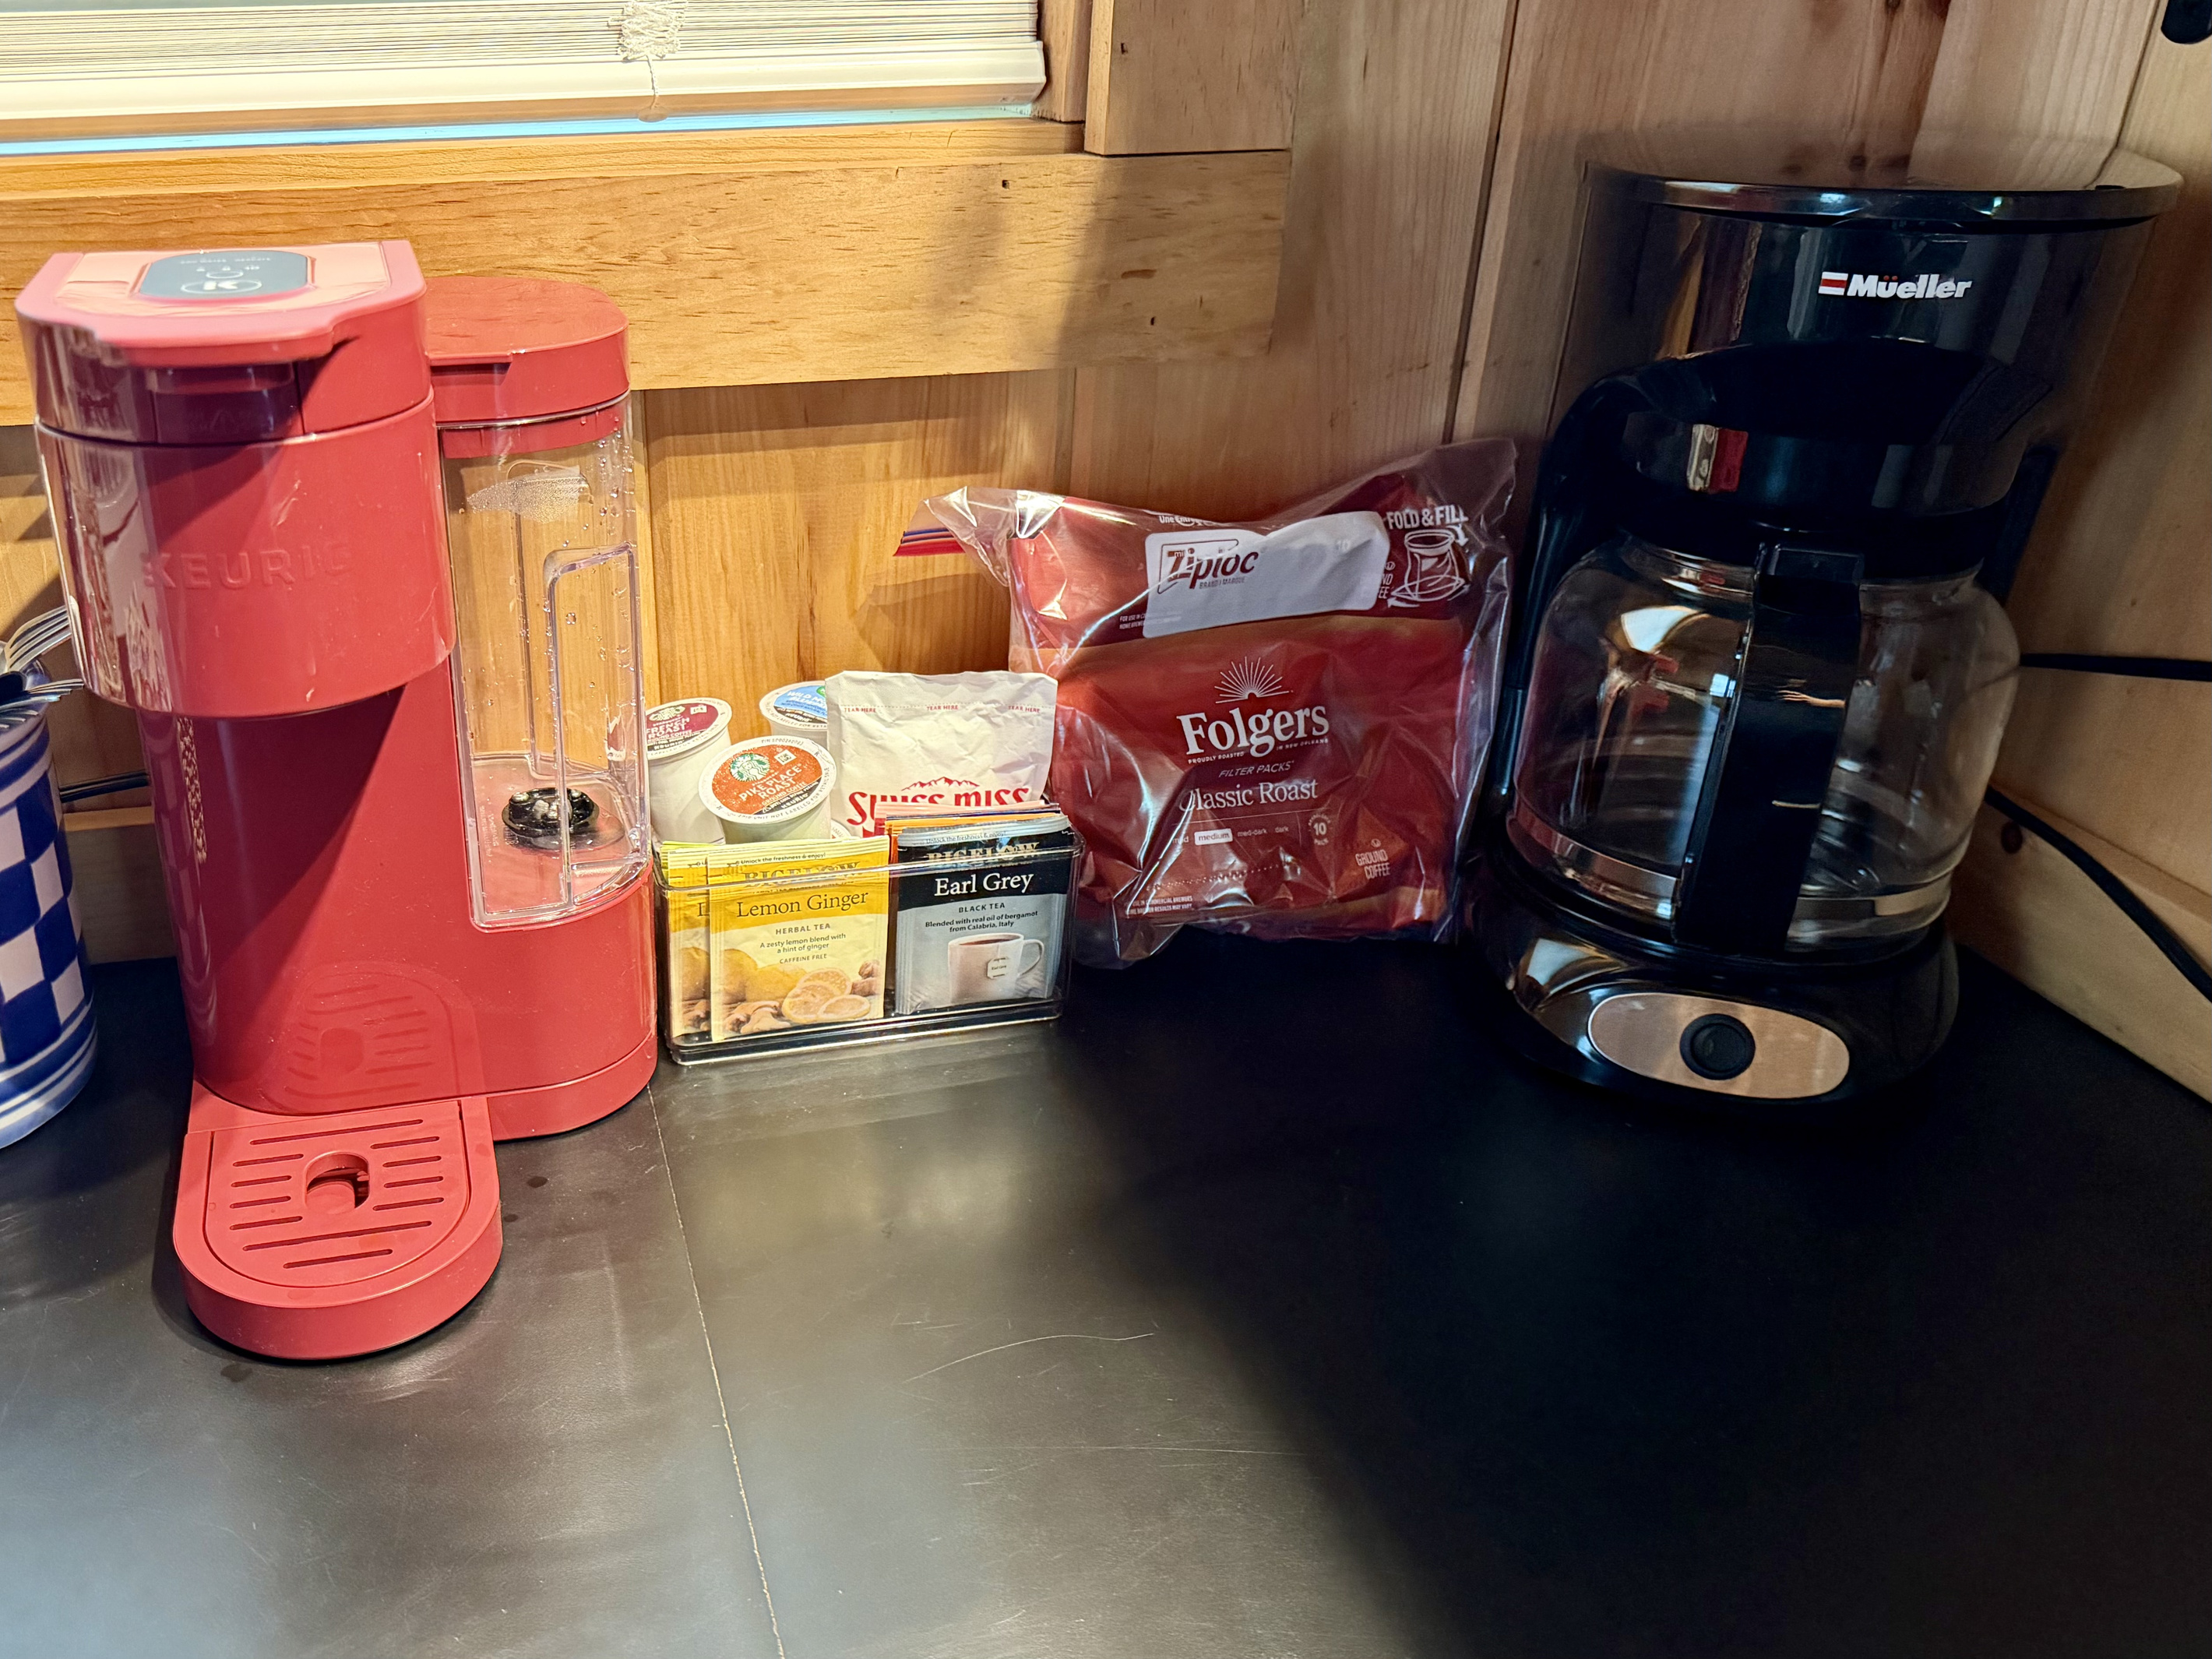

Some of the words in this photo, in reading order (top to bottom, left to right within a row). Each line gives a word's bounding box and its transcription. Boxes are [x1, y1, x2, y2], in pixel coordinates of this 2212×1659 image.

[1847, 273, 1973, 299] Müeller
[1386, 511, 1419, 530] FOLD
[1421, 508, 1435, 527] &
[1435, 505, 1469, 524] FILL
[140, 544, 352, 590] KEURIG
[1166, 547, 1259, 590] Ziploc
[648, 722, 686, 740] ROAST
[1175, 705, 1330, 758] Folgers
[1187, 755, 1217, 765] PROUDLY
[1217, 751, 1245, 761] ROASTED
[1218, 766, 1255, 778] FILTER
[738, 783, 767, 801] PIKE
[757, 777, 796, 799] ROAST
[1178, 784, 1255, 812] Classic
[1258, 779, 1319, 804] Roast
[785, 801, 811, 815] LABELED
[1198, 832, 1231, 842] medium
[1237, 827, 1268, 838] med-dark
[1312, 822, 1327, 836] 10
[1355, 849, 1389, 866] GROUND
[1364, 862, 1391, 879] COFFEE
[934, 874, 977, 896] Earl
[983, 872, 1034, 893] Grey
[737, 900, 802, 918] Lemon
[807, 893, 868, 912] Ginger
[959, 904, 987, 913] BLACK
[956, 917, 971, 925] with
[1004, 911, 1038, 920] bergamot
[776, 925, 812, 935] HERBAL
[766, 939, 785, 948] zesty
[786, 937, 808, 946] lemon
[807, 942, 830, 952] ginger
[779, 955, 810, 964] CAFFEINE
